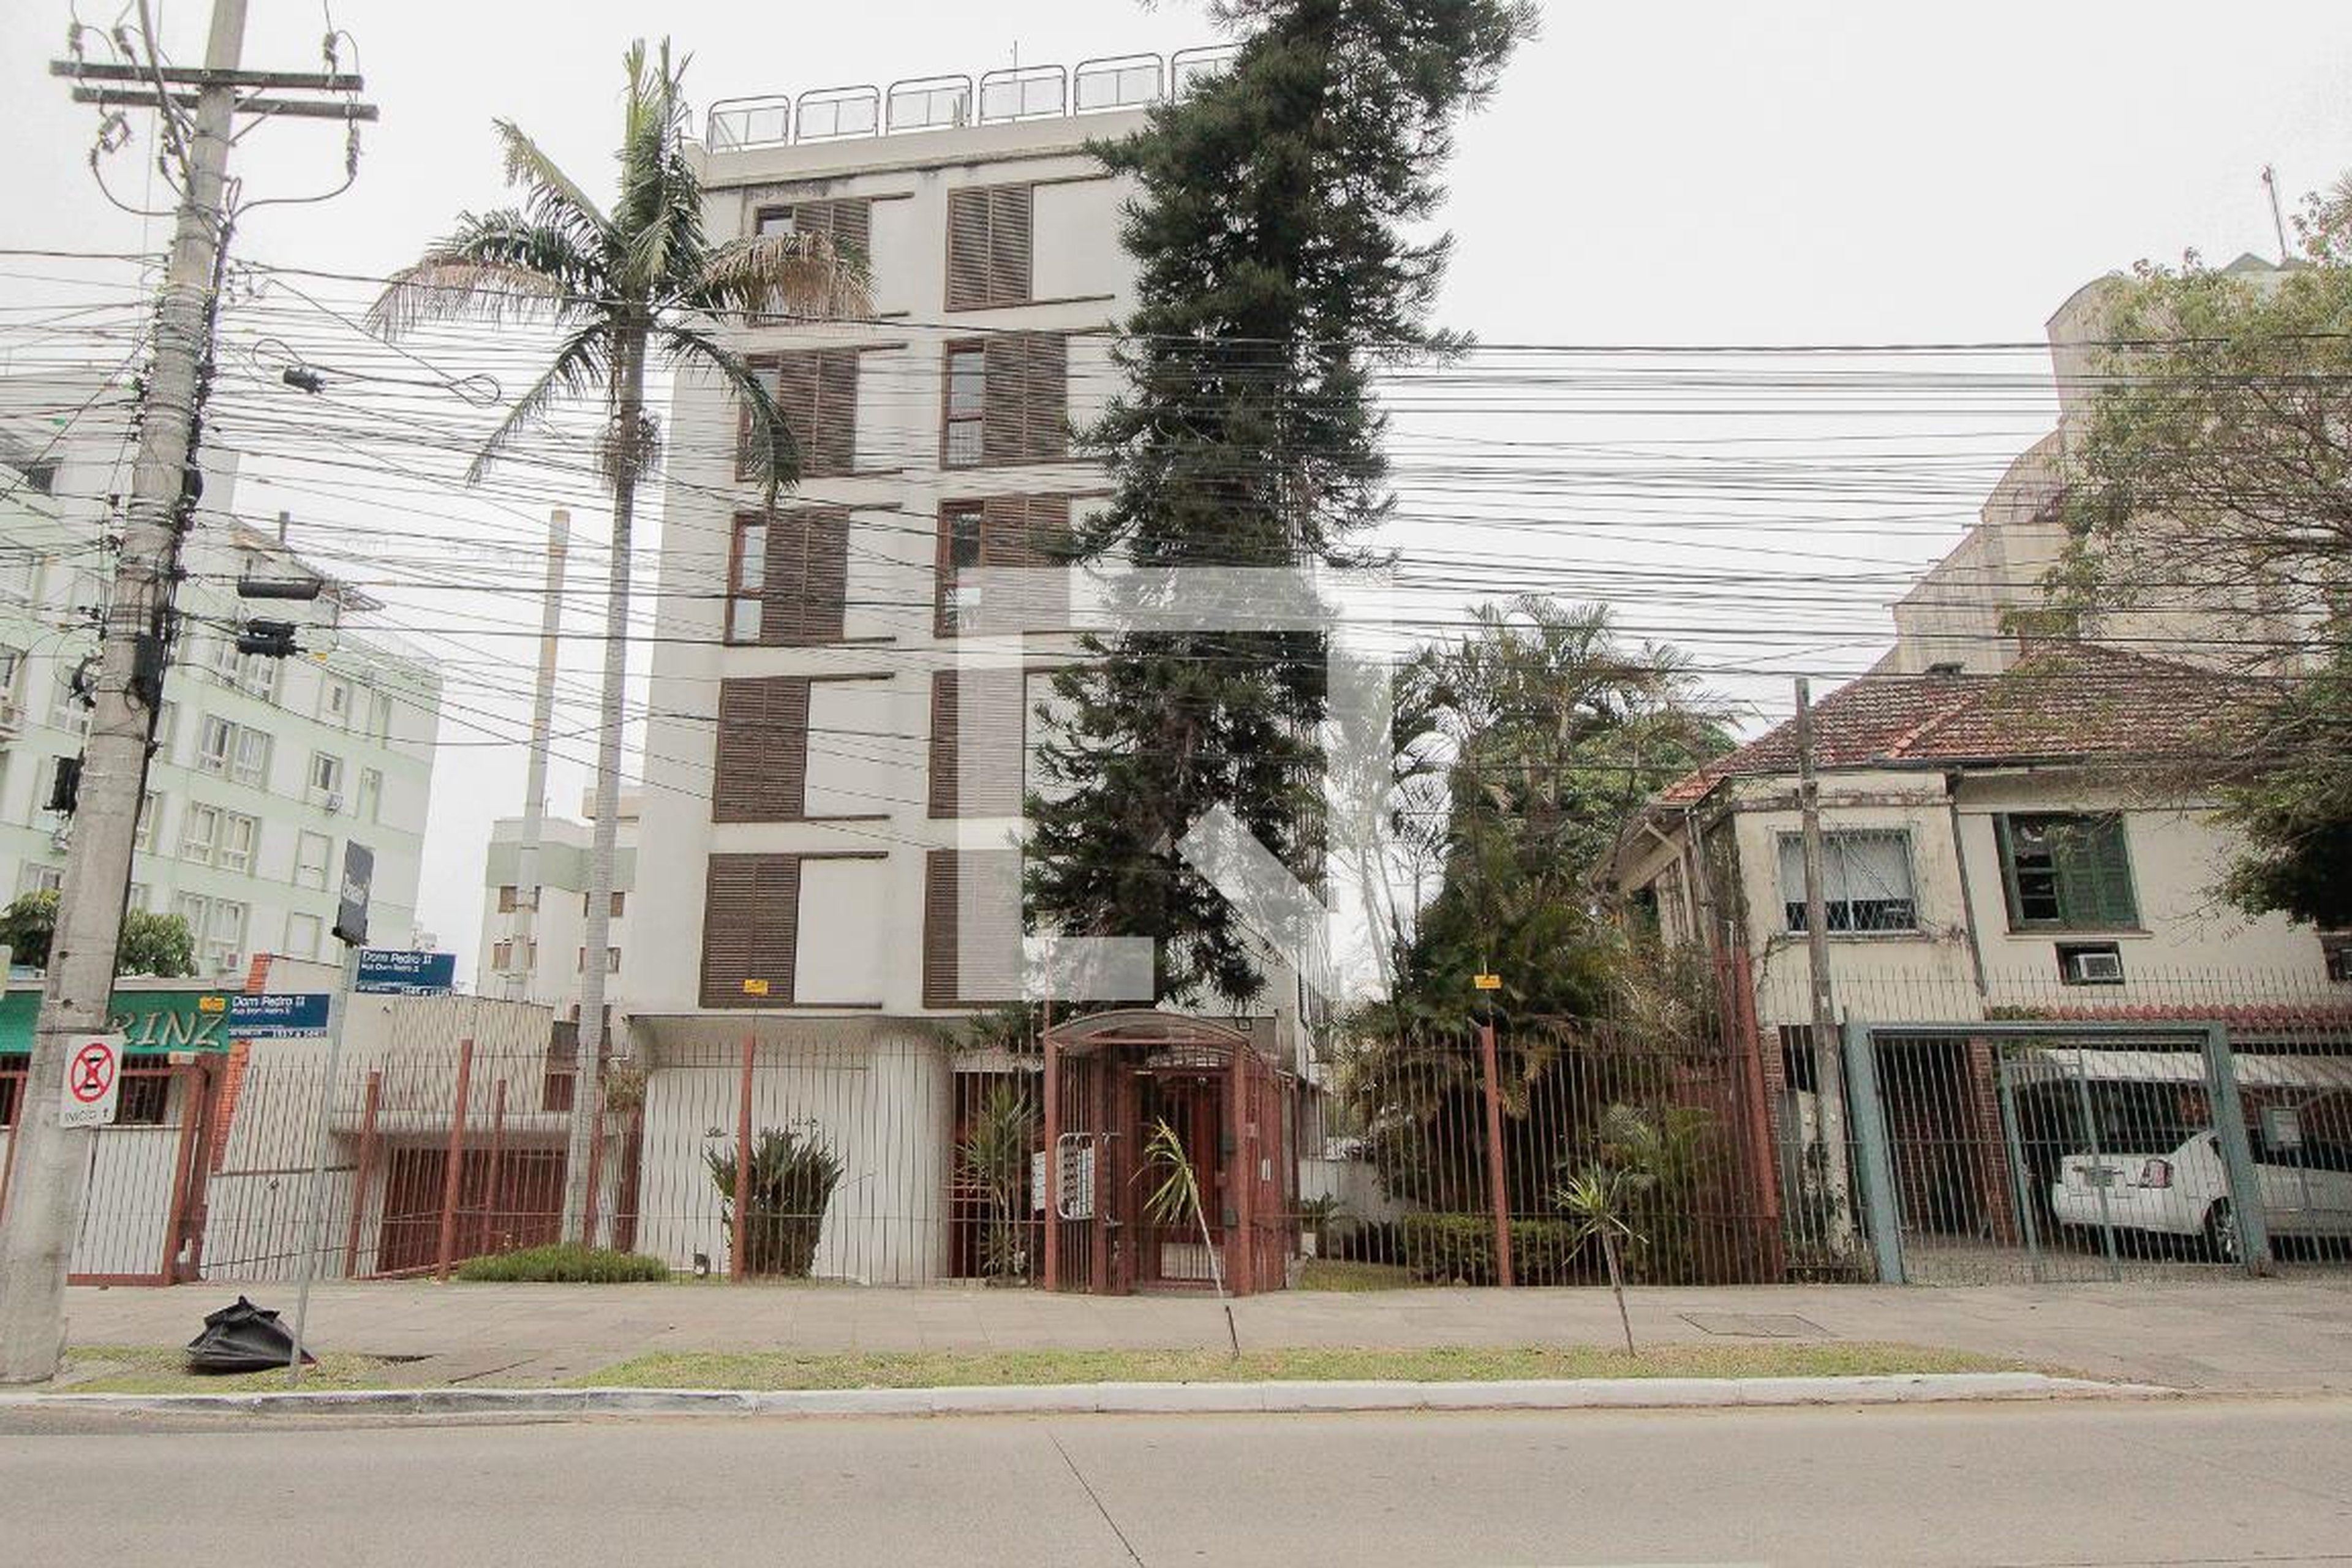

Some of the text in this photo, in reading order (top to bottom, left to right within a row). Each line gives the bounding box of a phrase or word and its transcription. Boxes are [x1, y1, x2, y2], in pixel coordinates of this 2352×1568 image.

[362, 951, 432, 965] Dom Pedro II
[232, 996, 258, 1007] Dom
[261, 996, 293, 1006] Pedro
[295, 996, 306, 1007] II
